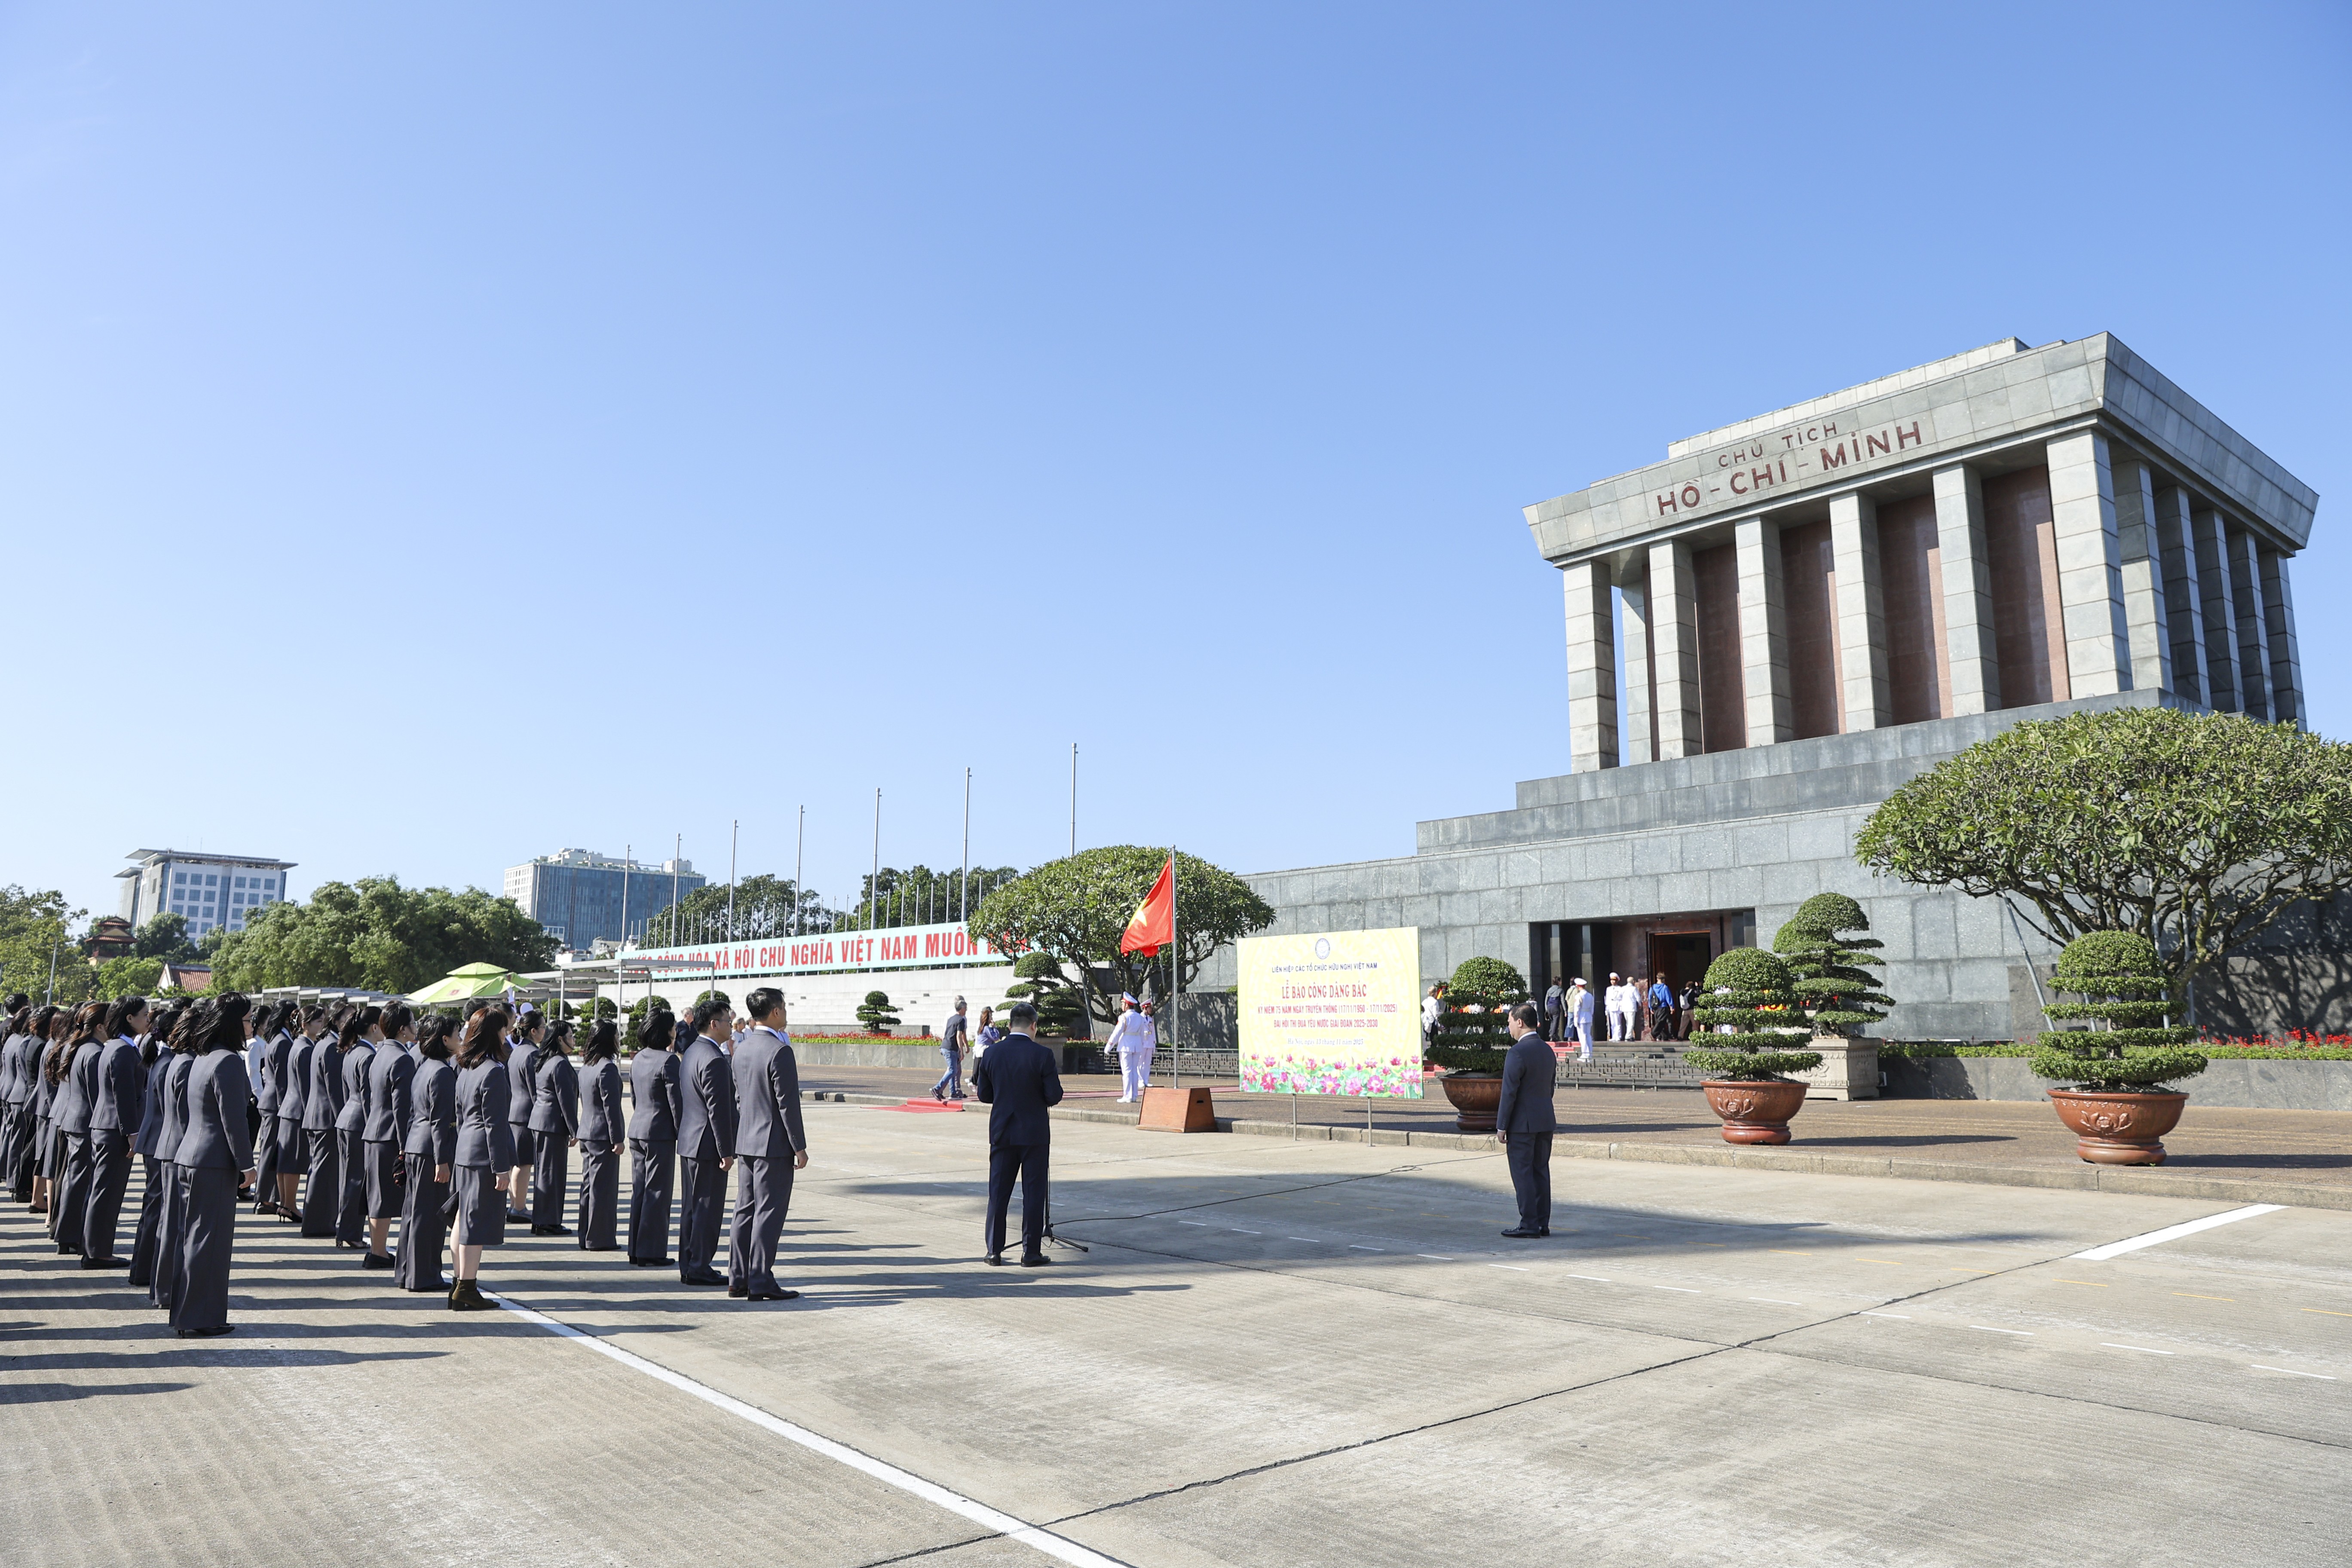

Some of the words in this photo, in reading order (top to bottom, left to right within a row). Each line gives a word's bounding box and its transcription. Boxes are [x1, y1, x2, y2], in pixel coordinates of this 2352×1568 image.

[1718, 440, 1764, 468] CHỦ
[1782, 421, 1838, 451] TỊCH
[1657, 479, 1700, 516] HỒ
[1730, 453, 1787, 494] CHÍ
[1820, 421, 1922, 471] MINH
[714, 947, 729, 970] XÃ
[735, 944, 755, 972] HỘI
[760, 939, 785, 968] CHỦ
[791, 938, 833, 966] NGHĨA
[841, 934, 874, 966] VIỆT
[881, 934, 917, 961] NAM
[925, 926, 978, 959] MUÔN
[1283, 965, 1294, 973] HIỆP
[1307, 962, 1313, 971] TỔ
[1354, 962, 1365, 971] VIỆT
[1282, 980, 1289, 999] LỄ
[1292, 982, 1305, 999] BÁO
[1308, 981, 1327, 998] CÔNG
[1329, 981, 1350, 998] DÂNG
[1352, 980, 1367, 997] BÁC
[1276, 1006, 1281, 1014] 75
[1339, 1004, 1365, 1014] (17/11/1950
[1370, 1004, 1397, 1014] 17/11/2025)
[1298, 1019, 1306, 1028] ĐUA
[1307, 1018, 1316, 1028] YÊU
[1330, 1019, 1339, 1028] GIAI
[1354, 1019, 1378, 1028] 2025-2030
